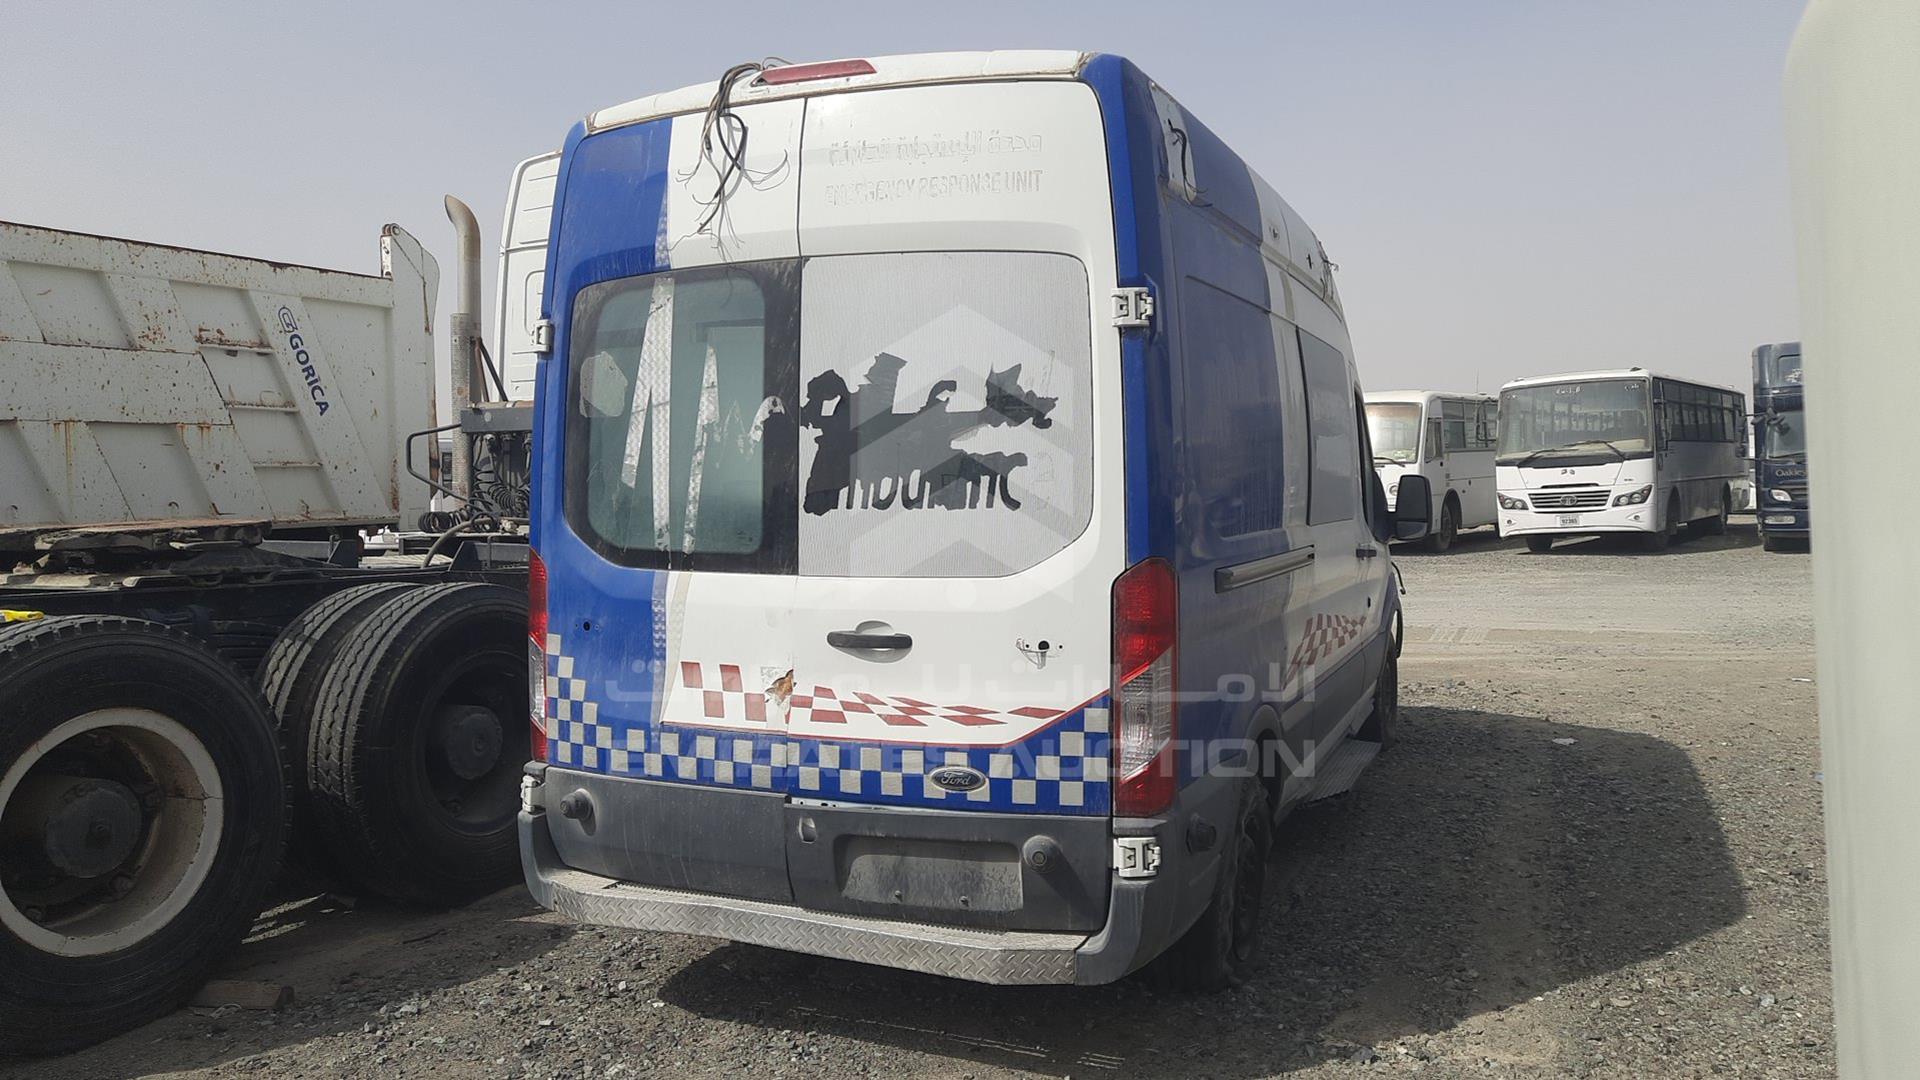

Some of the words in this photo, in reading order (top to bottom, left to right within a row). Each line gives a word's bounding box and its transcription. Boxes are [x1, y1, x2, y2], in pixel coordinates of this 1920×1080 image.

[919, 170, 1001, 199] RESPONSE
[1004, 169, 1044, 193] UNIT
[941, 771, 972, 785] Ford
